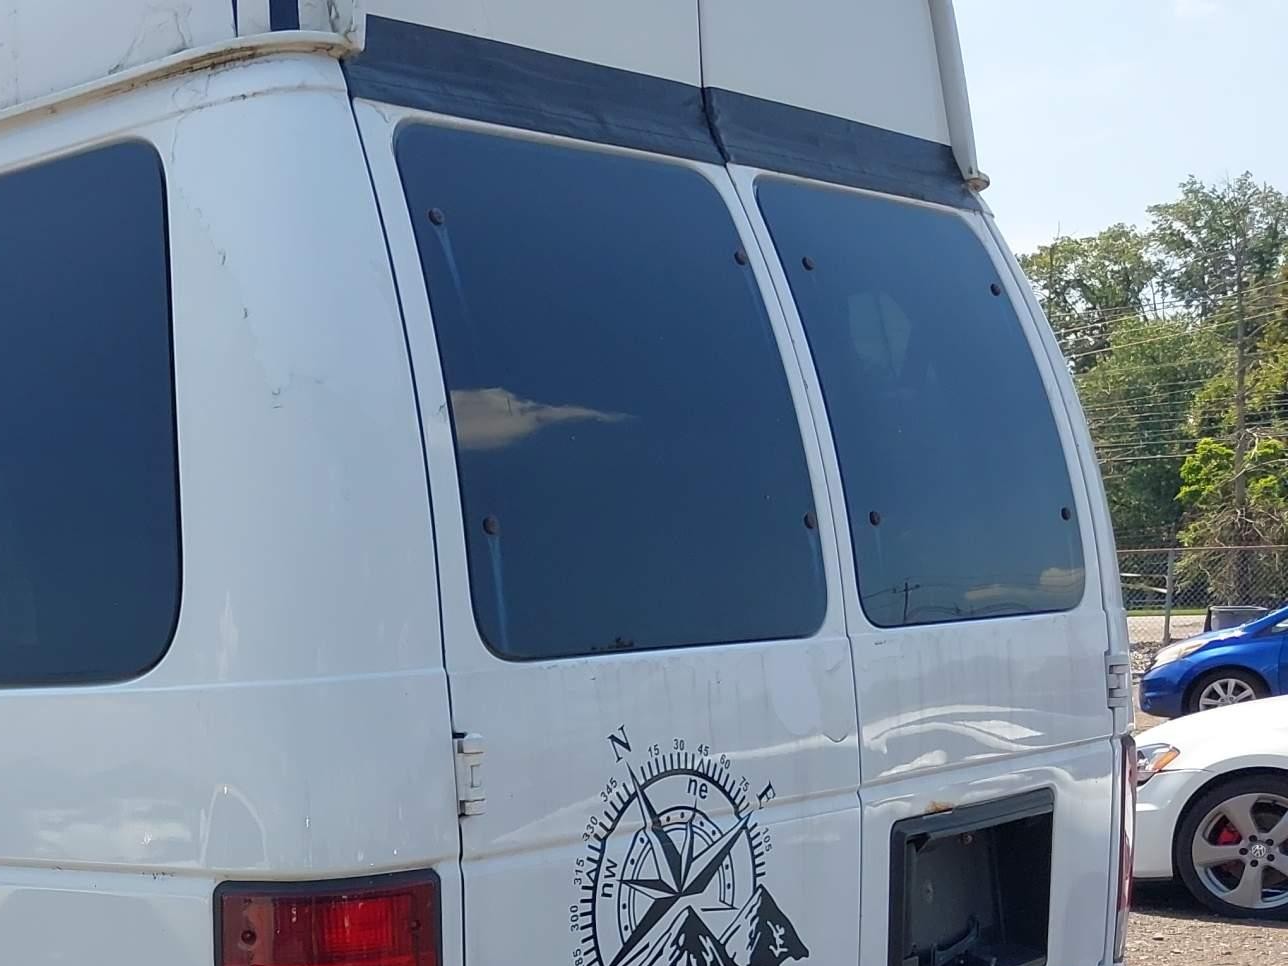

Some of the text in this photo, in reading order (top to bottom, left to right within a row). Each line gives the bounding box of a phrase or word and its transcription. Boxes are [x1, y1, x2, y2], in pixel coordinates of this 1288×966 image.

[607, 724, 632, 763] N
[647, 744, 660, 758] 15
[673, 739, 685, 751] 30
[697, 744, 710, 757] 45
[719, 754, 731, 770] 60
[600, 777, 618, 803] 345
[687, 777, 709, 799] ne
[739, 776, 750, 793] 75
[756, 780, 777, 810] E
[582, 816, 598, 842] 330
[762, 827, 773, 852] 105
[573, 858, 585, 886] 315
[601, 858, 618, 898] nw
[570, 905, 579, 932] 300
